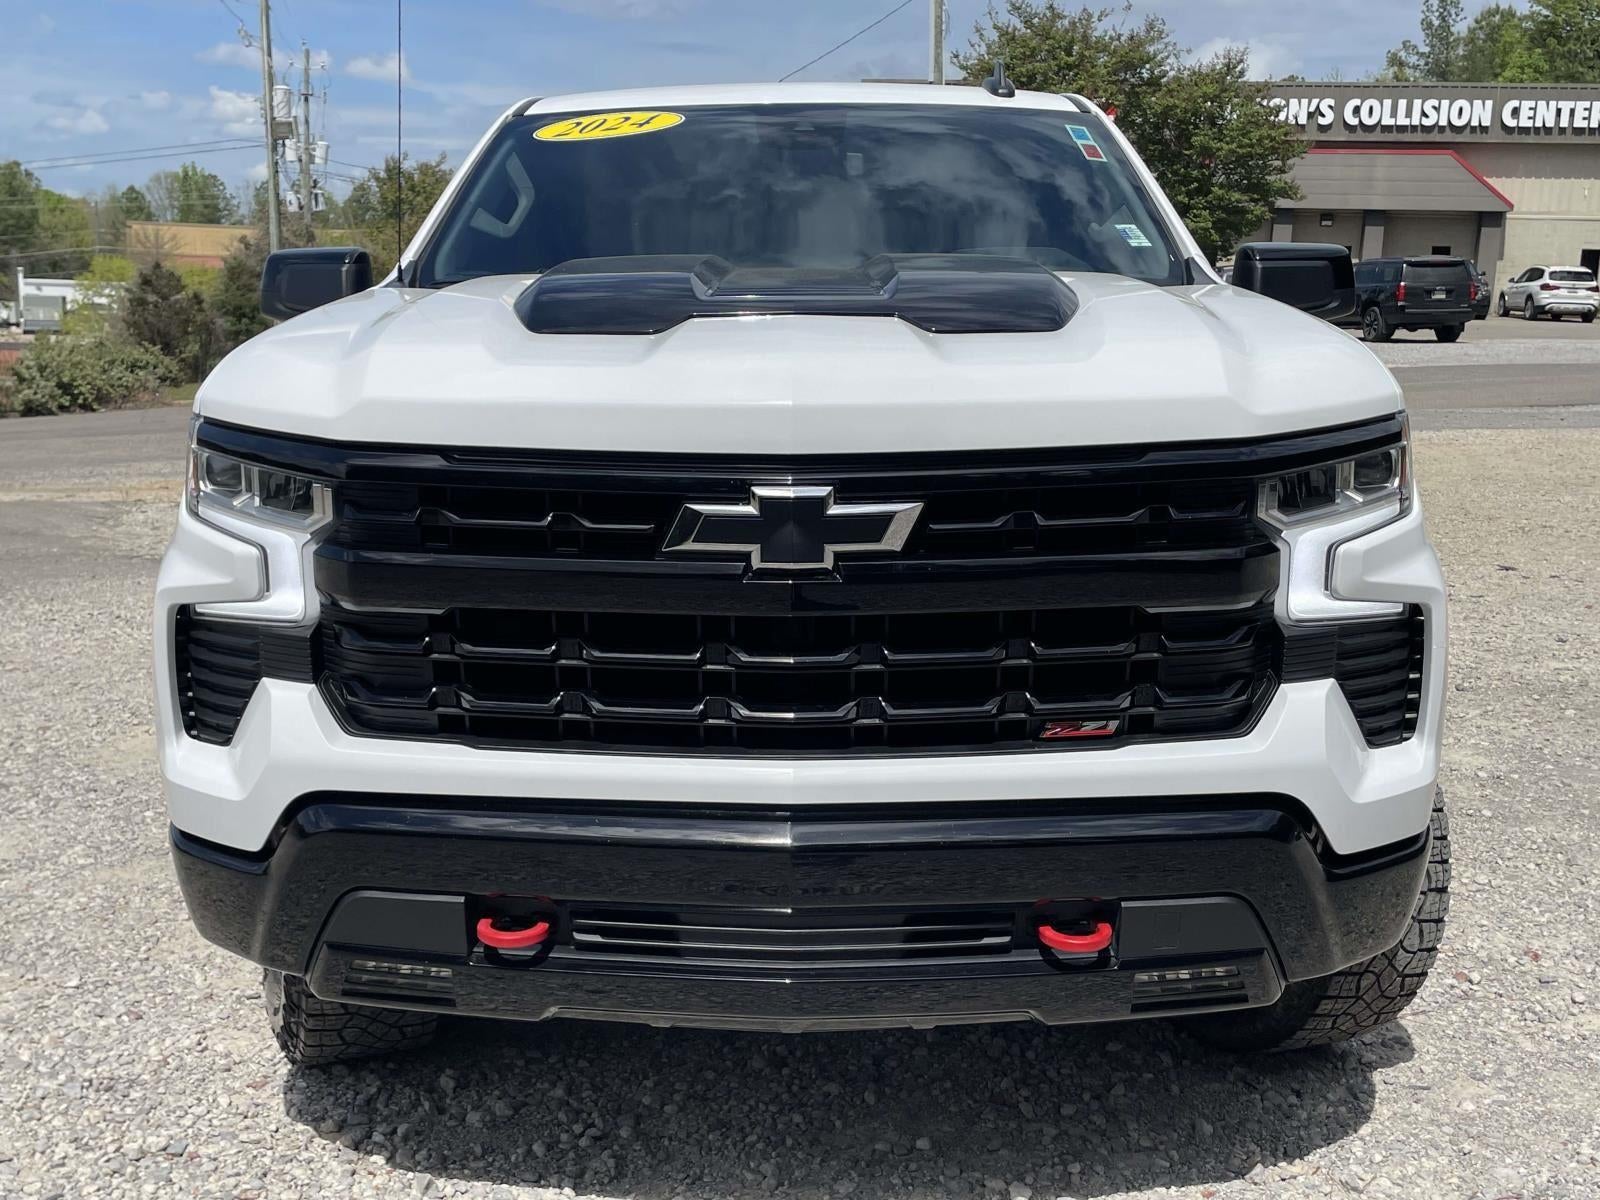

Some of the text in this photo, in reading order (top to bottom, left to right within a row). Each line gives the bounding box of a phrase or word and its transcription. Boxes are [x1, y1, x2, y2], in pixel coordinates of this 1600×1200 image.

[1343, 98, 1493, 127] COLLISION
[552, 113, 662, 138] 2024
[1040, 720, 1120, 739] Z71
